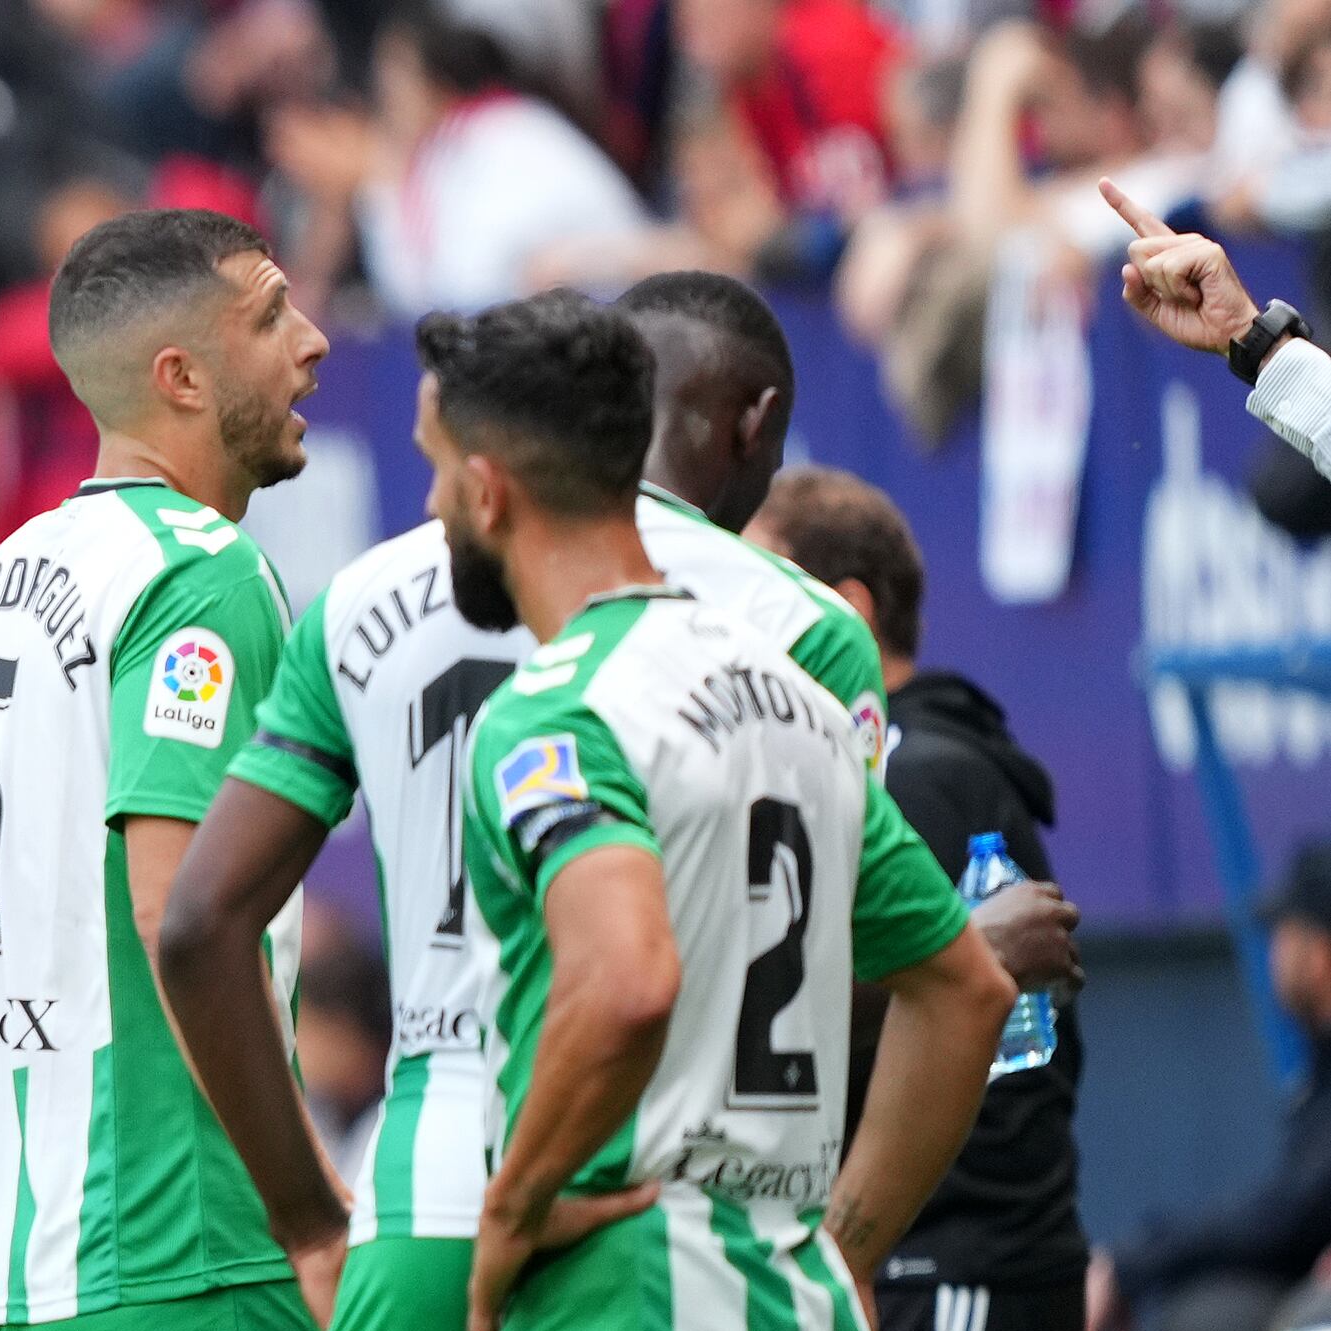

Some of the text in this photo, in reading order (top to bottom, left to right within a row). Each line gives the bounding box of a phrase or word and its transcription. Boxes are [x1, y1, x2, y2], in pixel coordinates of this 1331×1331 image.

[338, 565, 451, 694] LUIZ
[154, 705, 216, 730] LaLiga
[725, 795, 820, 1112] 2
